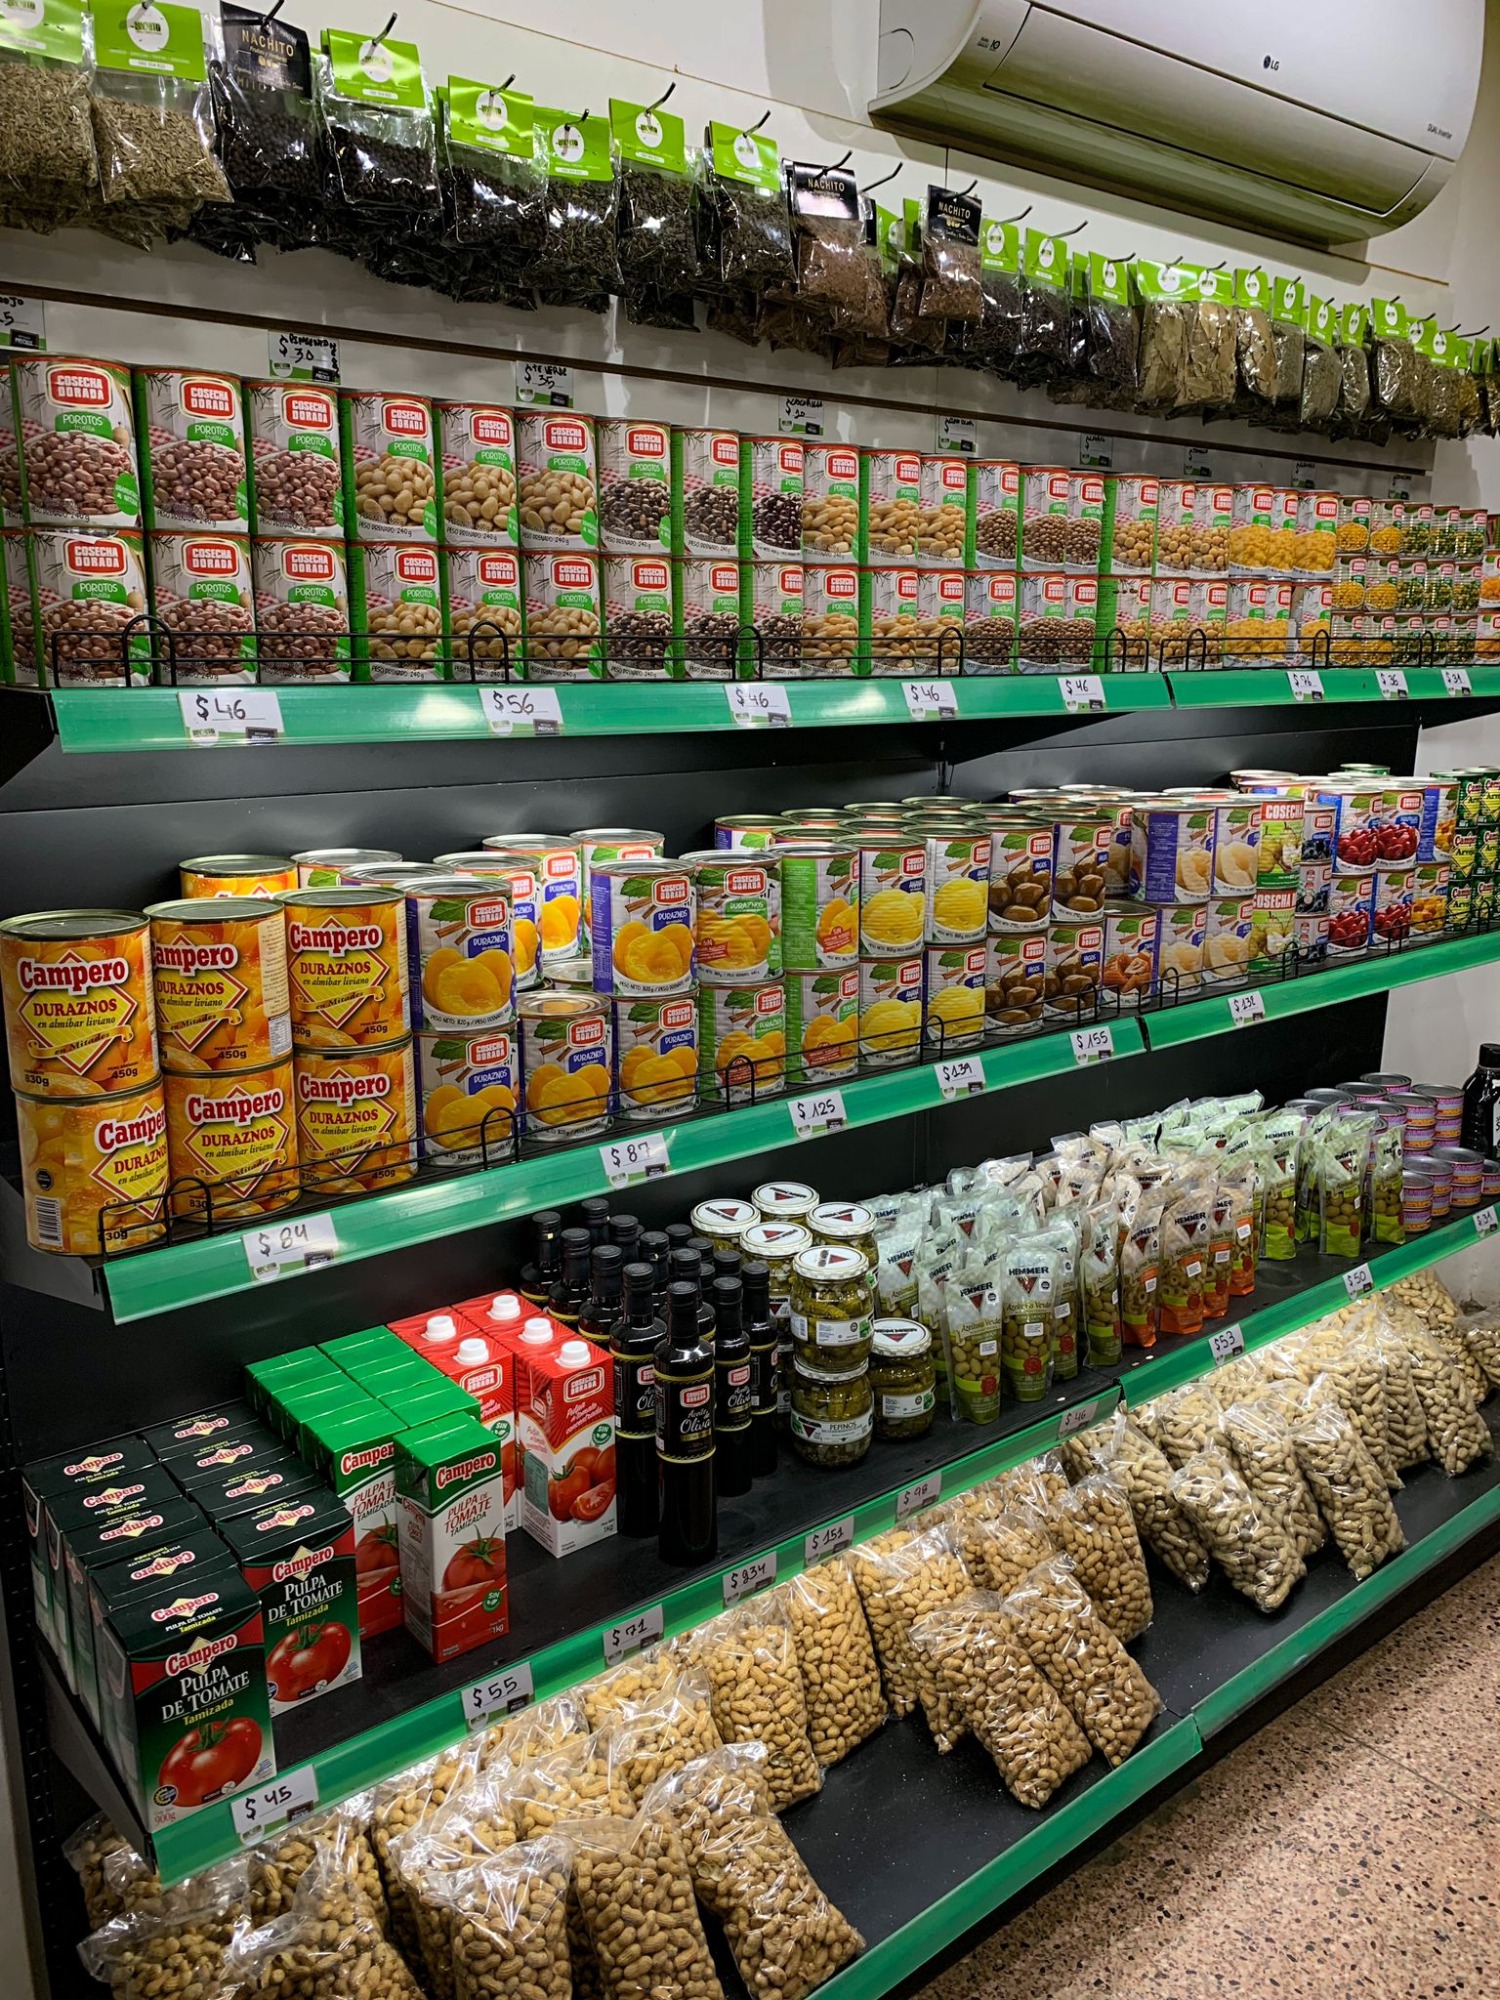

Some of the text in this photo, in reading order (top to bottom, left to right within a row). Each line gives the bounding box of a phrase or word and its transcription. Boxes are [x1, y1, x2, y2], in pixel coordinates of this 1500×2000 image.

[241, 29, 295, 58] NACHITO
[1270, 60, 1279, 71] LG
[807, 177, 846, 192] NACHITO
[937, 201, 971, 219] NACHITO
[56, 374, 103, 390] COSECHA
[57, 386, 105, 401] DORADA
[190, 387, 229, 401] COSECHA
[190, 397, 230, 412] DORADA
[291, 400, 328, 414] COSECHA
[62, 413, 103, 427] POROTOS
[291, 410, 328, 424] DORADA
[390, 409, 423, 423] COSECHA
[194, 425, 229, 437] POROTOS
[551, 426, 582, 438] COSECHA
[295, 435, 327, 447] POROTOS
[393, 441, 423, 454] POROTOS
[481, 451, 508, 462] POROTOS
[553, 456, 582, 468] POROTOS
[73, 545, 118, 558] COSECHA
[191, 548, 232, 561] COSECHA
[291, 553, 329, 565] COSECHA
[74, 556, 119, 569] DORADA
[192, 557, 233, 570] DORADA
[291, 562, 329, 574] DORADA
[80, 581, 118, 594] POROTOS
[196, 583, 232, 594] POROTOS
[294, 586, 328, 598] POROTOS
[732, 874, 761, 885] COSECHA
[474, 900, 504, 914] COSECHA
[730, 899, 764, 911] DURAZNOS
[658, 909, 688, 922] DURAZNOS
[290, 924, 380, 954] Campero
[473, 933, 506, 948] DURAZNOS
[19, 959, 127, 993] Campero
[300, 961, 371, 976] DURAZNOS
[157, 982, 225, 997] DURAZNOS
[33, 998, 118, 1018] DURAZNOS
[37, 1020, 48, 1029] en
[85, 1015, 116, 1029] liviano
[364, 1024, 388, 1035] 450g
[69, 1032, 110, 1051] Mitades
[664, 1031, 693, 1046] DURAZNOS
[218, 1048, 248, 1061] 450g
[572, 1048, 604, 1063] DURAZNOS
[25, 1073, 50, 1087] 830g
[111, 1067, 138, 1080] 450g
[473, 1069, 507, 1084] DURAZNOS
[299, 1074, 388, 1104] Campero
[187, 1091, 281, 1122] Campero
[309, 1108, 379, 1125] DURAZNOS
[201, 1126, 276, 1147] DURAZNOS
[372, 1168, 396, 1181] 450g
[1175, 1211, 1207, 1225] HEMMER
[1008, 1265, 1049, 1276] HEMMER
[960, 1281, 993, 1298] HEMMER
[565, 1402, 586, 1418] Pulpa
[176, 1418, 229, 1438] Campero
[494, 1422, 509, 1432] SIN
[596, 1425, 610, 1436] SIN
[680, 1417, 711, 1434] Oliva
[829, 1421, 857, 1432] PEPINOS
[197, 1444, 252, 1467] Campero
[64, 1453, 123, 1475] Campero
[436, 1452, 496, 1489] Campero
[226, 1474, 282, 1497] Campero
[354, 1481, 386, 1505] PULPA
[84, 1484, 144, 1507] Campero
[356, 1497, 395, 1523] TAMIZADA
[447, 1491, 489, 1519] PULPA DE
[257, 1504, 315, 1531] Campero
[444, 1499, 492, 1534] TOMATE
[450, 1510, 487, 1538] TAMIZADA
[101, 1515, 162, 1540] Campero
[132, 1552, 194, 1580] Campero
[273, 1546, 335, 1582] Campero
[284, 1574, 327, 1602] PULPA
[488, 1591, 500, 1600] SIN
[152, 1593, 219, 1621] Campero
[268, 1581, 343, 1623] DE TOMATE
[164, 1606, 224, 1632] PULPA DE TOMATE
[285, 1603, 329, 1627] Tamizada
[179, 1614, 216, 1633] Tamizada
[492, 1623, 505, 1635] 1kg
[167, 1634, 238, 1676] Campero
[179, 1665, 231, 1697] PULPA
[161, 1670, 250, 1721] DE TOMATE
[183, 1698, 235, 1726] Tamizada
